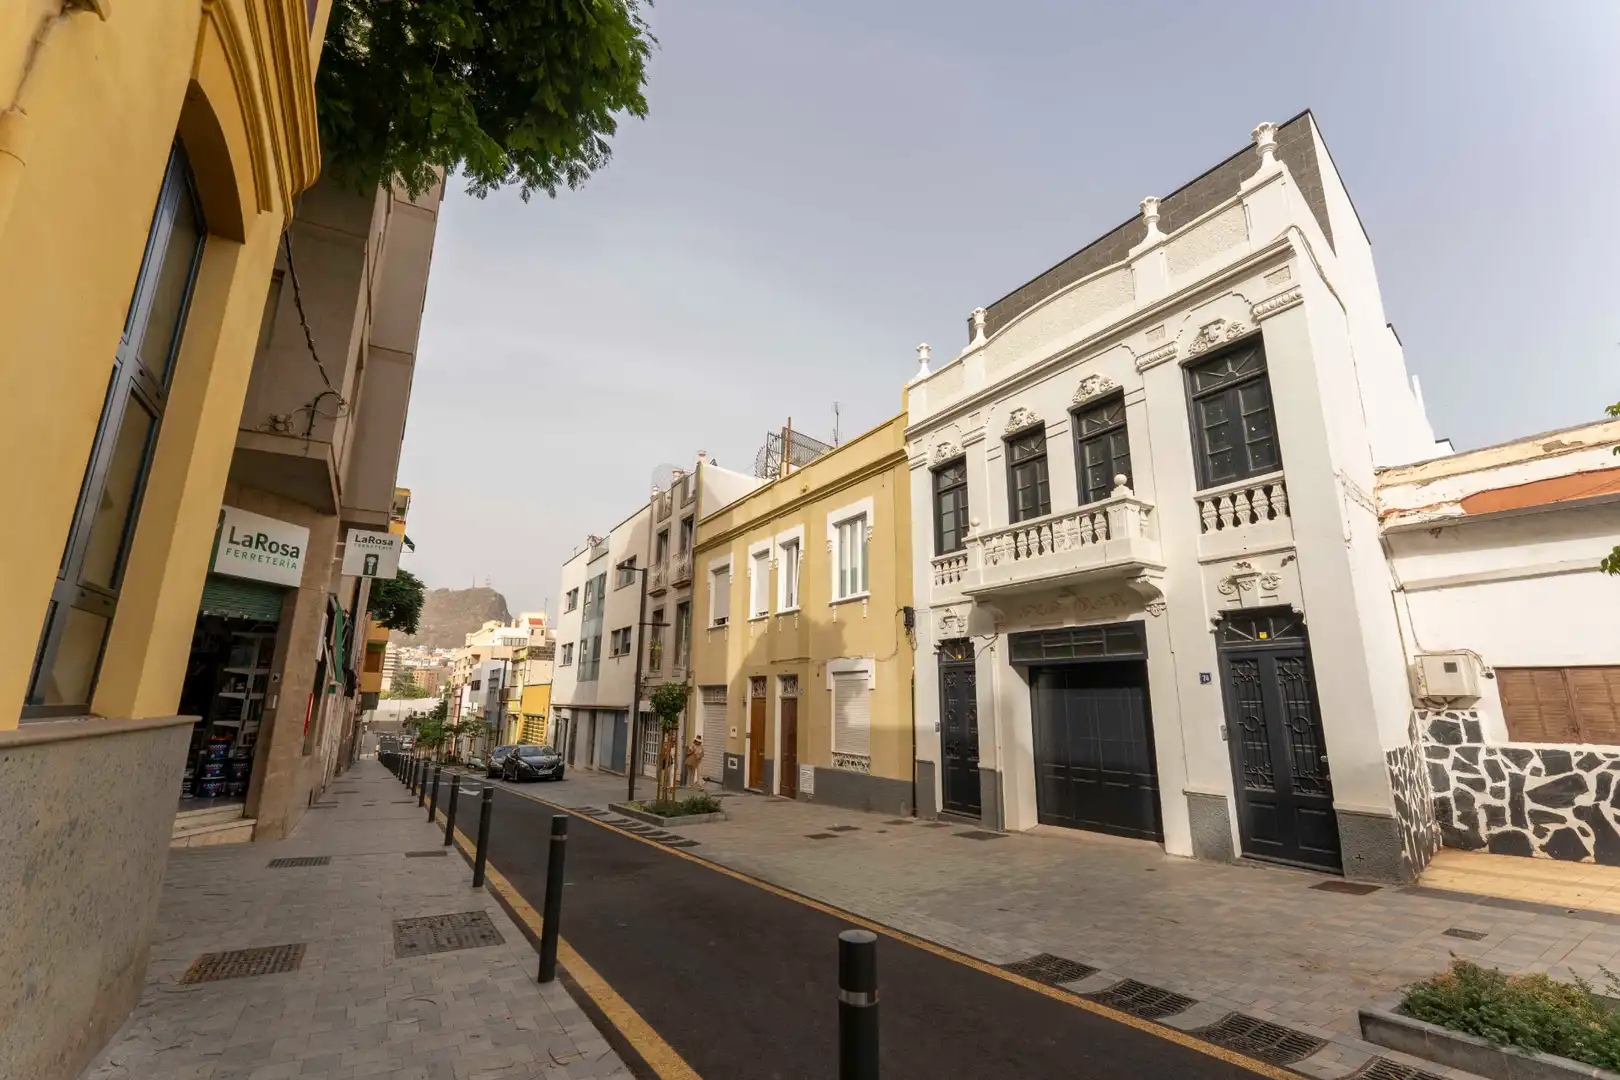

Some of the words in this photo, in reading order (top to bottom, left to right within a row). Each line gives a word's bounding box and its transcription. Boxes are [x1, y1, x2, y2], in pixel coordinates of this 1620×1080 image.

[228, 526, 300, 559] LaRosa
[355, 534, 394, 546] LaRosa
[226, 548, 297, 569] FERRETERÍA
